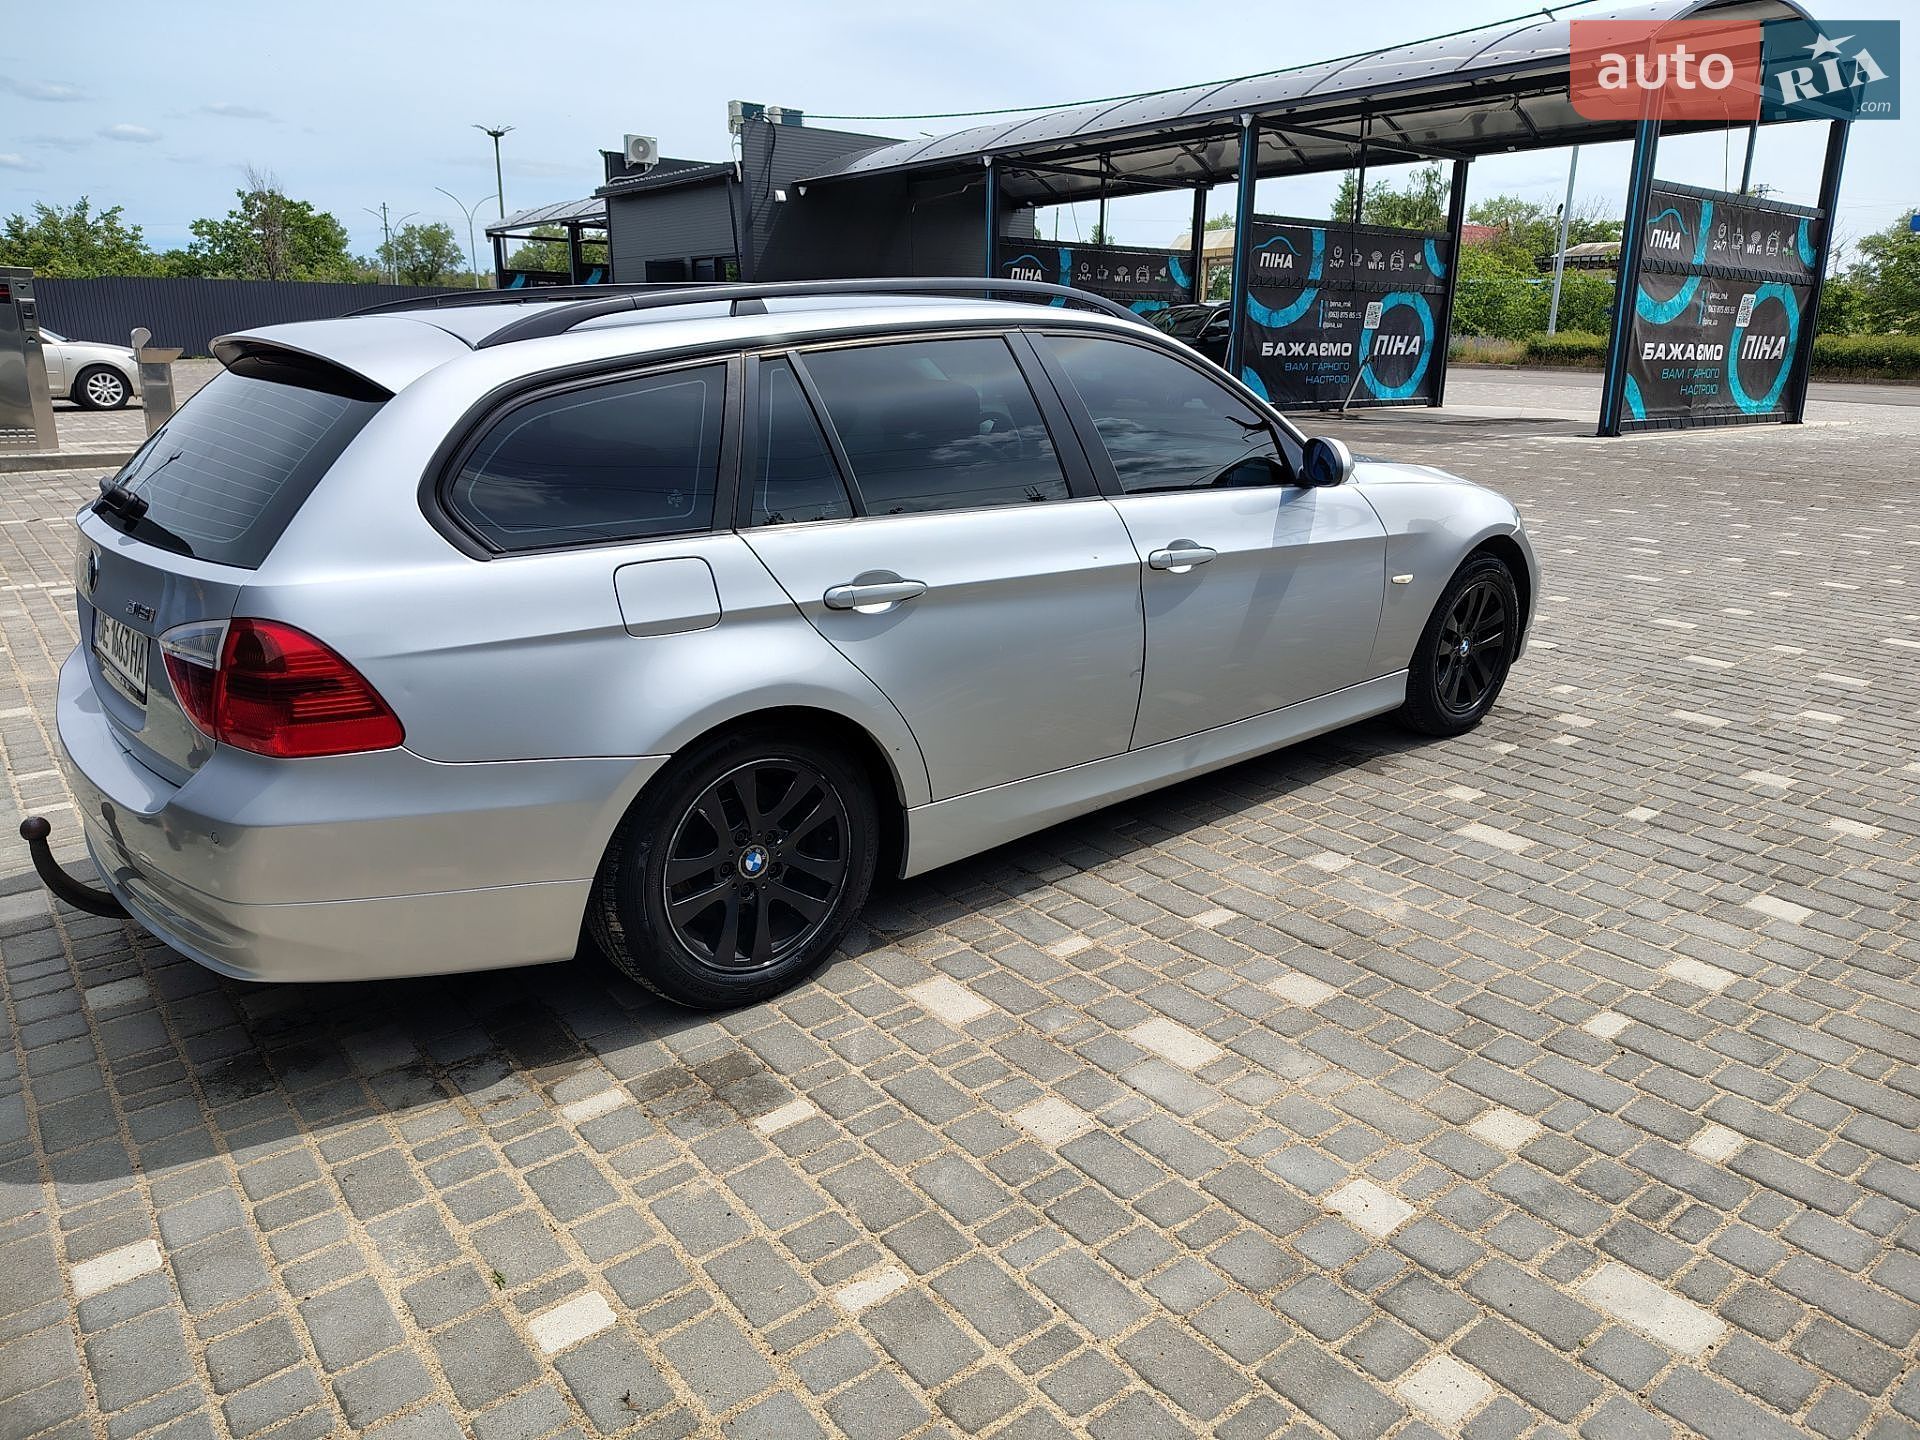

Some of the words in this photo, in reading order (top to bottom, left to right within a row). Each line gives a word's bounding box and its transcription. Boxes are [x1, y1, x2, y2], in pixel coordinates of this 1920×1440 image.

[1650, 229, 1681, 250] ПІНА
[1712, 240, 1727, 251] 24/7
[1259, 252, 1293, 269] ПІНА
[1329, 259, 1345, 269] 24/7
[1010, 267, 1043, 281] ПІНА
[1077, 273, 1092, 281] 24/7
[1261, 342, 1352, 357] БАЖАЄМО
[1373, 335, 1422, 356] ПІНА
[1642, 343, 1724, 361] БАЖАЄМО
[1741, 335, 1787, 360] ПІНА
[1284, 362, 1309, 372] ВАМ
[1311, 362, 1350, 371] ГАРНОГО
[1661, 368, 1685, 380] ВАМ
